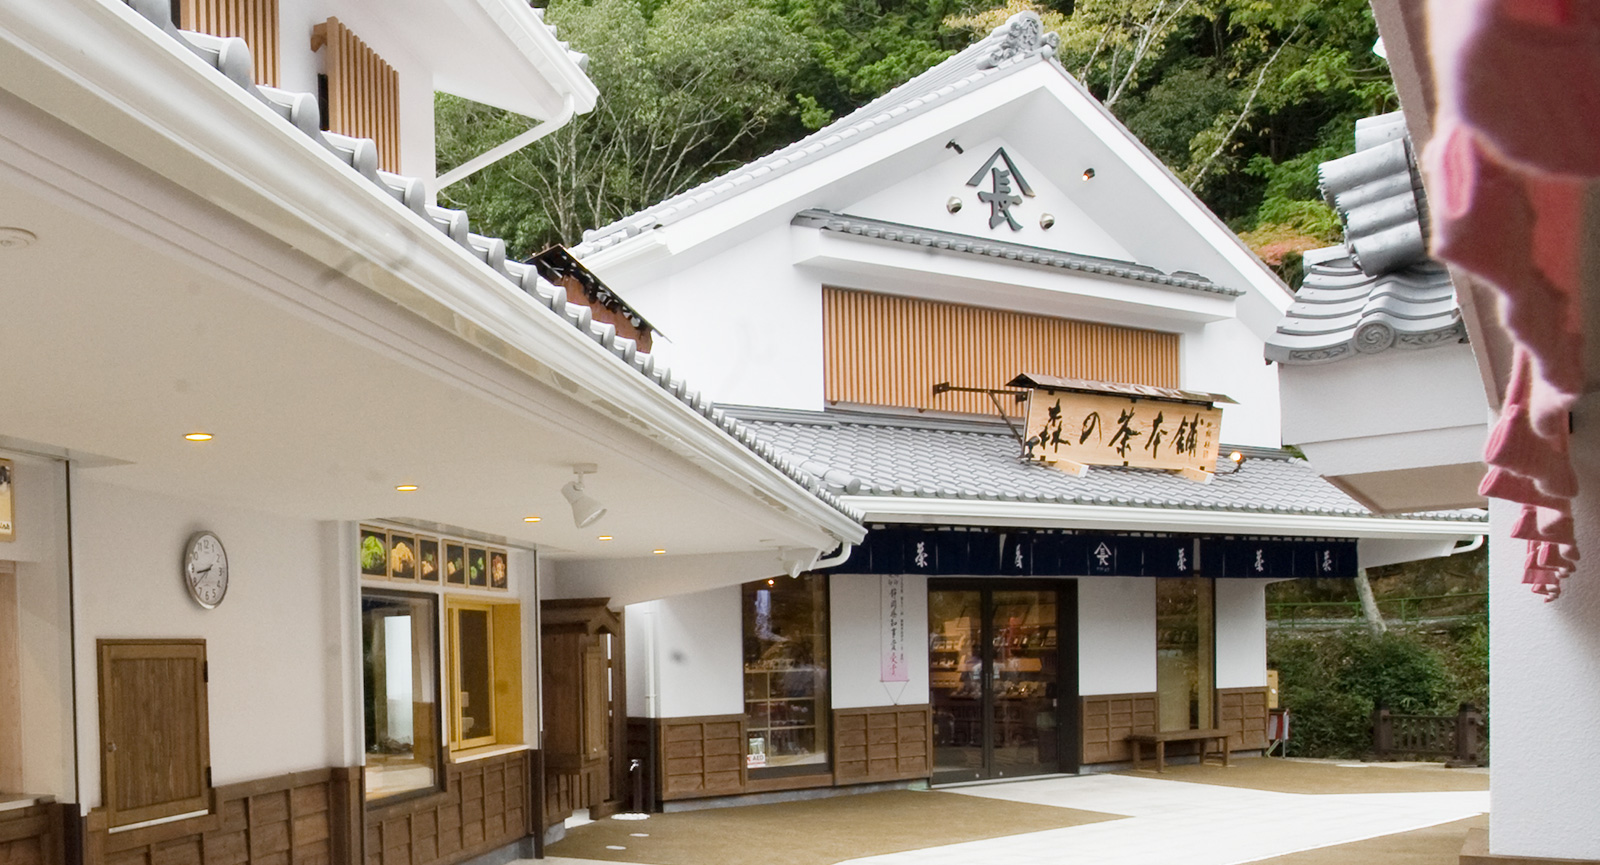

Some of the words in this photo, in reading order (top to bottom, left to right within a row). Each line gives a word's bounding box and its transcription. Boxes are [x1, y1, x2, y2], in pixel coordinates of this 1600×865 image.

[977, 167, 1023, 232] 長
[1039, 398, 1203, 459] 森の茶本舗
